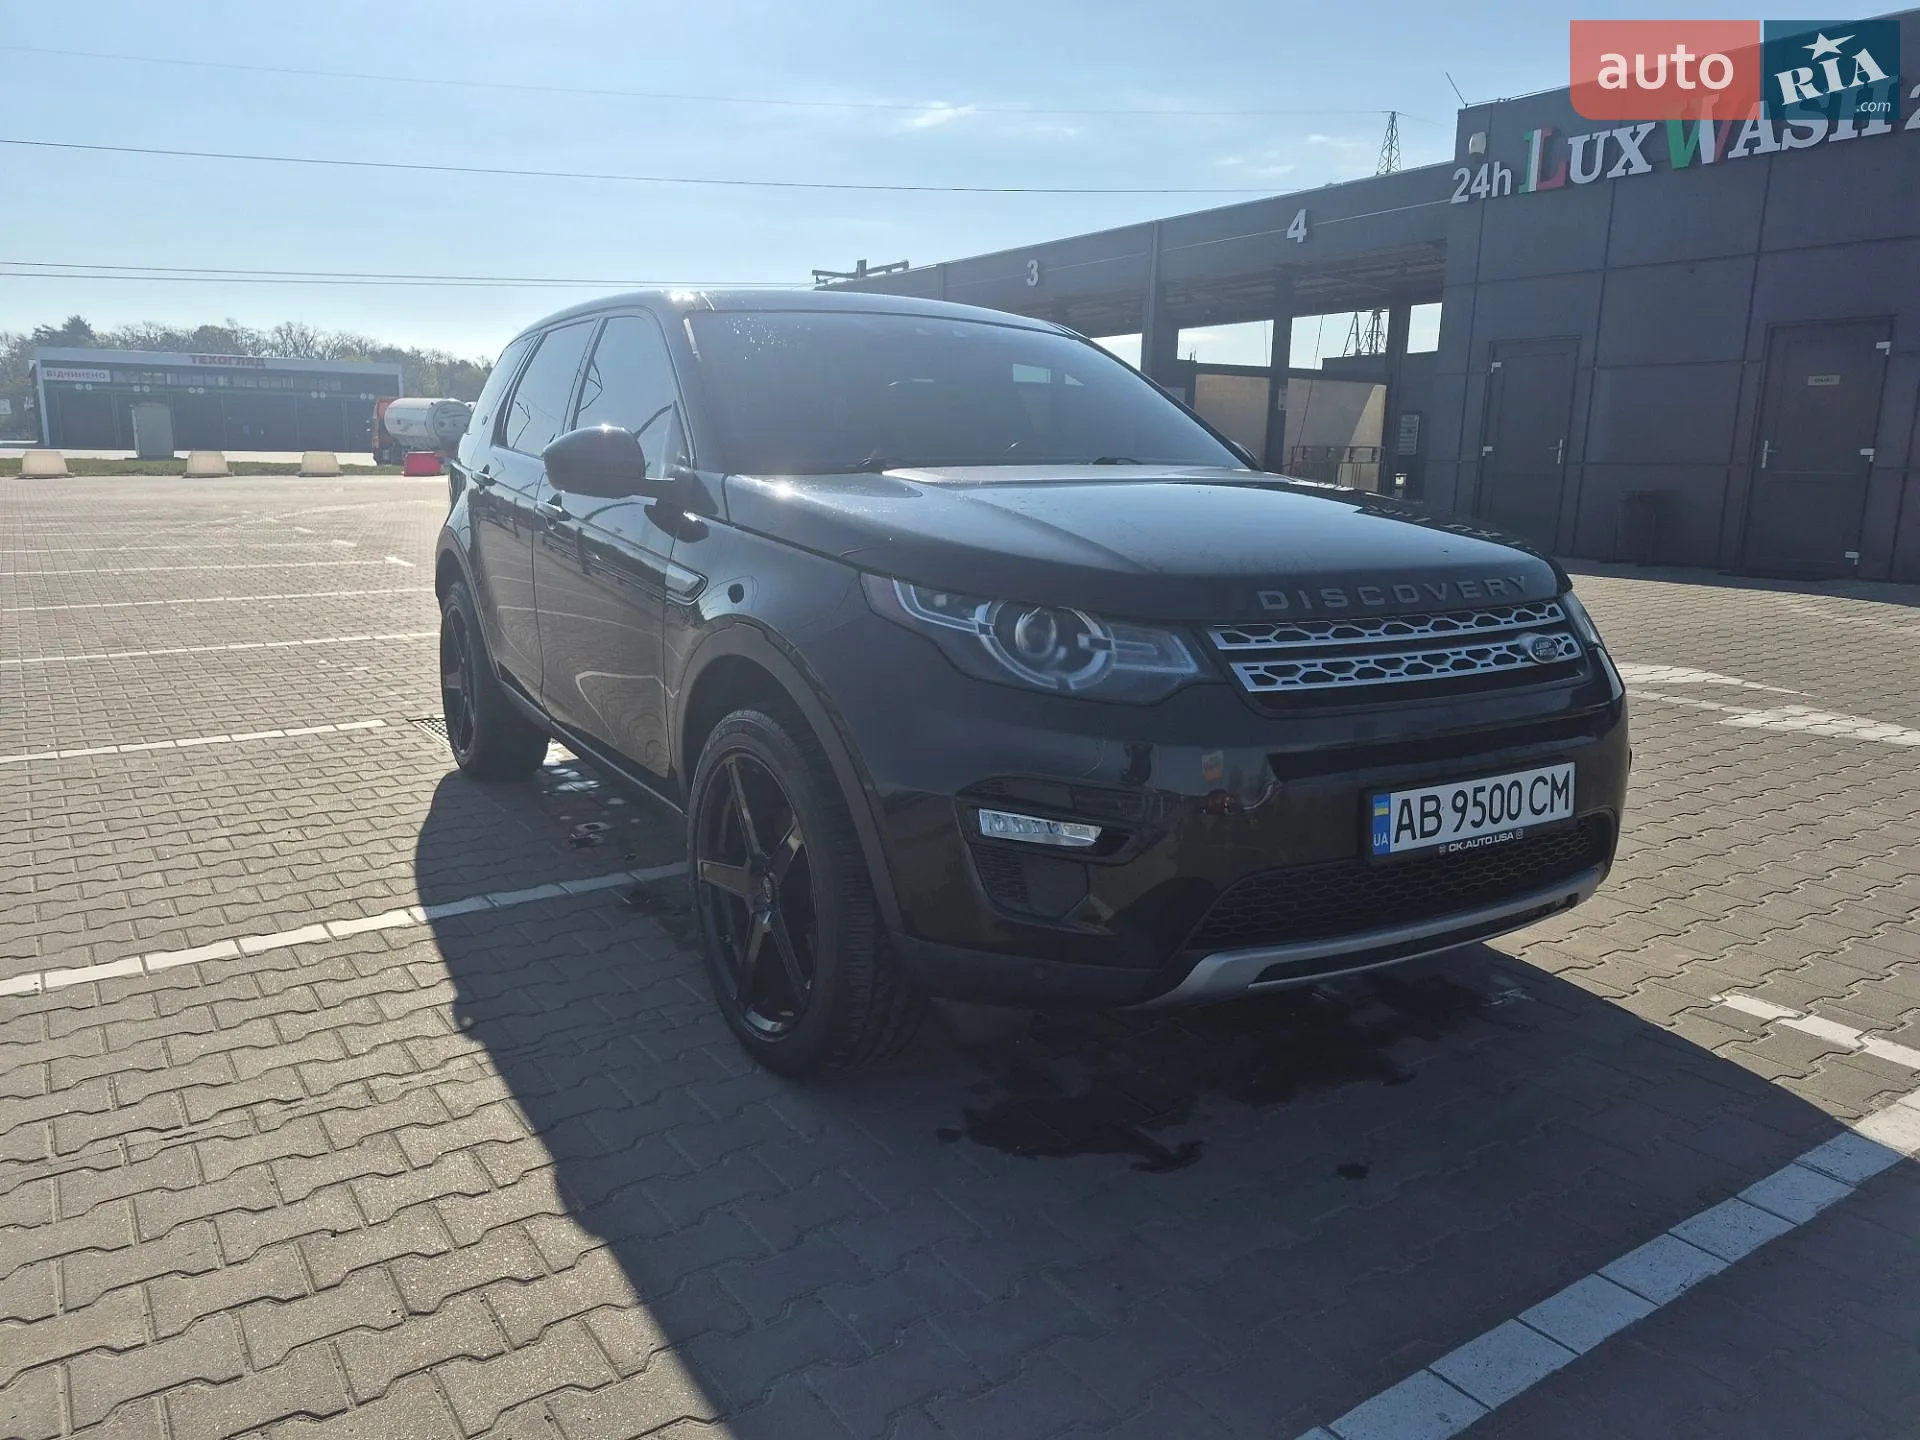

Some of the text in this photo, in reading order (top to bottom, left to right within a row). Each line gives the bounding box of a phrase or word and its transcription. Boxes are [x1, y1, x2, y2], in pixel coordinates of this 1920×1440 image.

[1450, 161, 1512, 204] 24h
[1286, 208, 1308, 243] 4
[1025, 259, 1040, 287] 3
[1256, 575, 1528, 612] DISCOVERY
[1393, 769, 1571, 845] AB 9500 CM
[1373, 832, 1390, 848] UA
